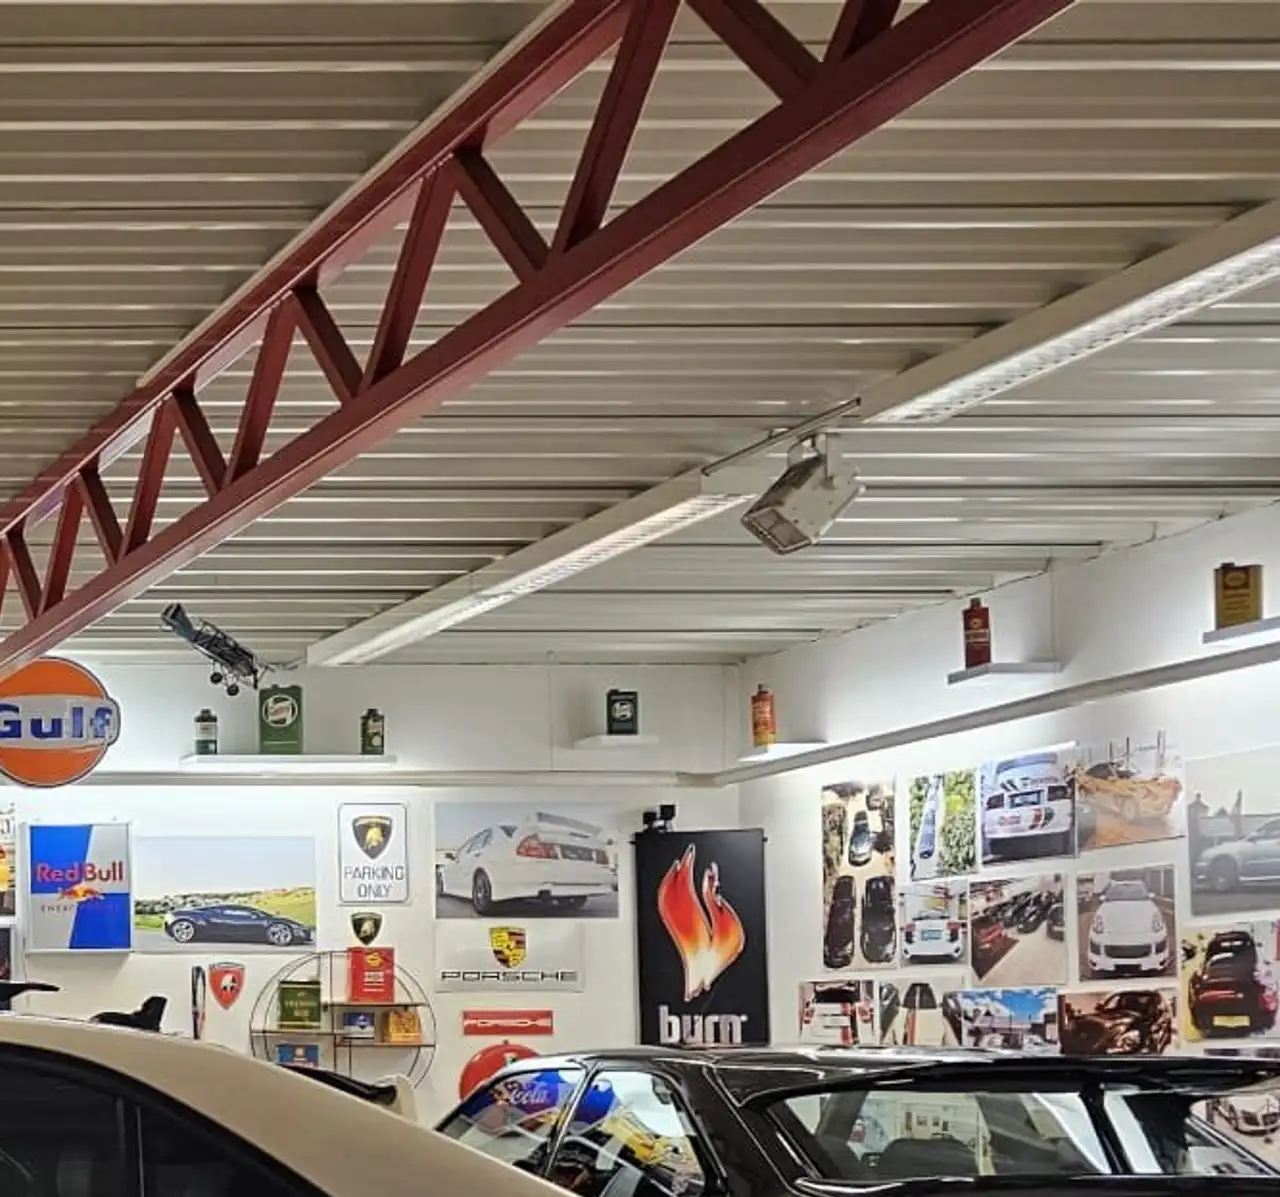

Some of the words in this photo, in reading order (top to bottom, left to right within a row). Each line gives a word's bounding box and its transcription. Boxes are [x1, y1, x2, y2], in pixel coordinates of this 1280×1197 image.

[37, 862, 83, 883] Red
[84, 861, 124, 881] Bull
[344, 866, 404, 880] PARKING
[357, 884, 391, 898] ONLY
[440, 971, 577, 981] PORSCHE
[659, 1004, 742, 1045] burn
